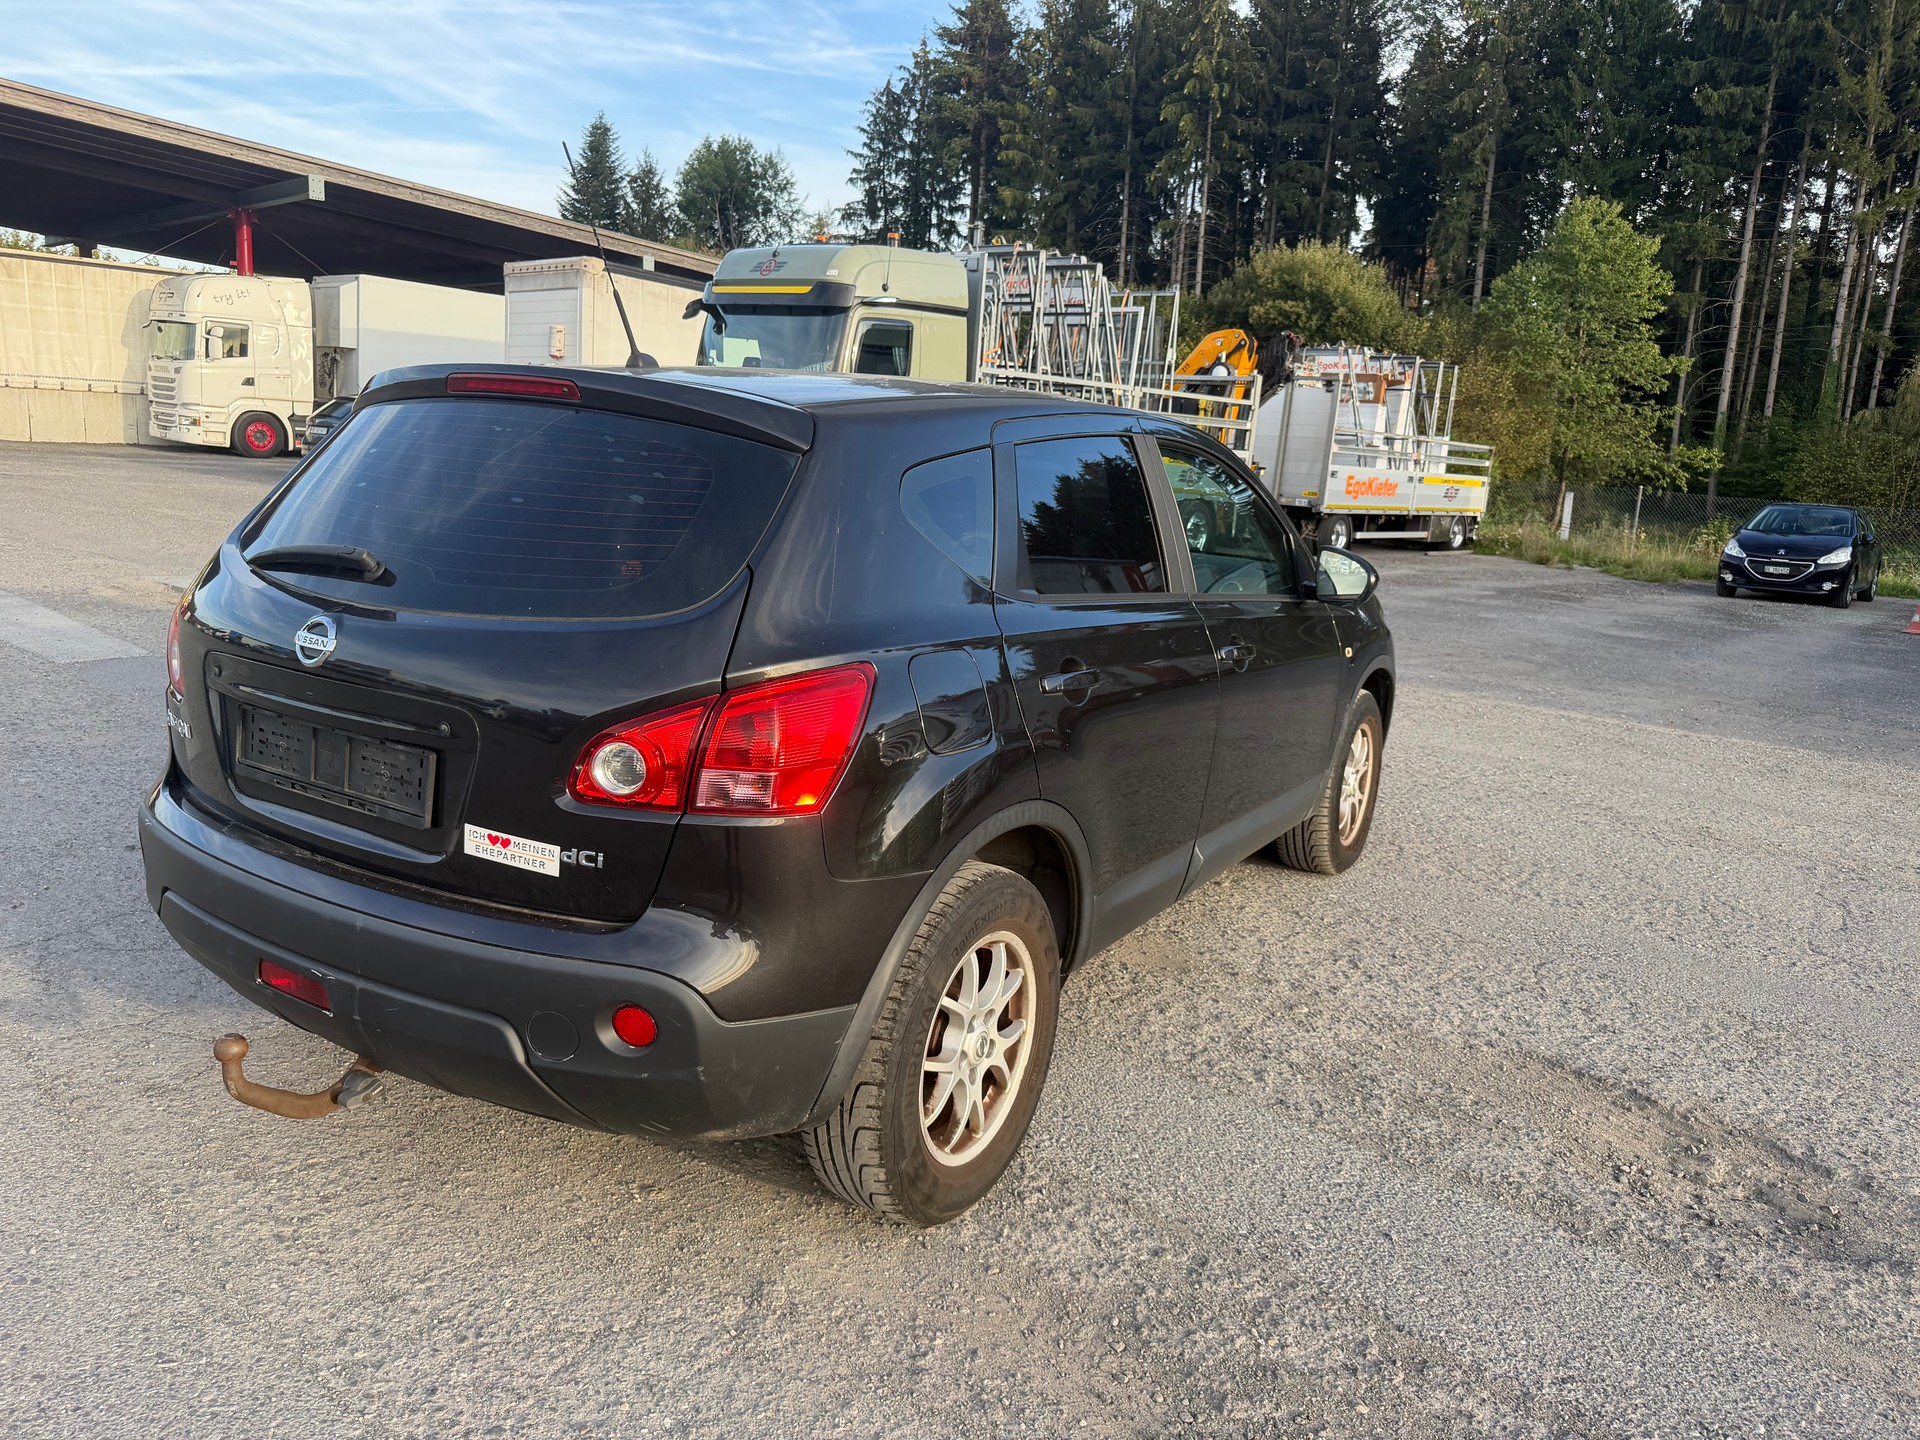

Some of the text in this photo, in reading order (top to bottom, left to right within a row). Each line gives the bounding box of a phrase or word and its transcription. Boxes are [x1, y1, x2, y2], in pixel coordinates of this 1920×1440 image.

[213, 288, 250, 306] try it!
[1345, 474, 1398, 500] EgoKiefer
[296, 633, 329, 648] NISSAN
[468, 829, 555, 858] ICH MEINEN
[474, 844, 546, 870] EHEPARTNER
[560, 848, 604, 869] dCi
